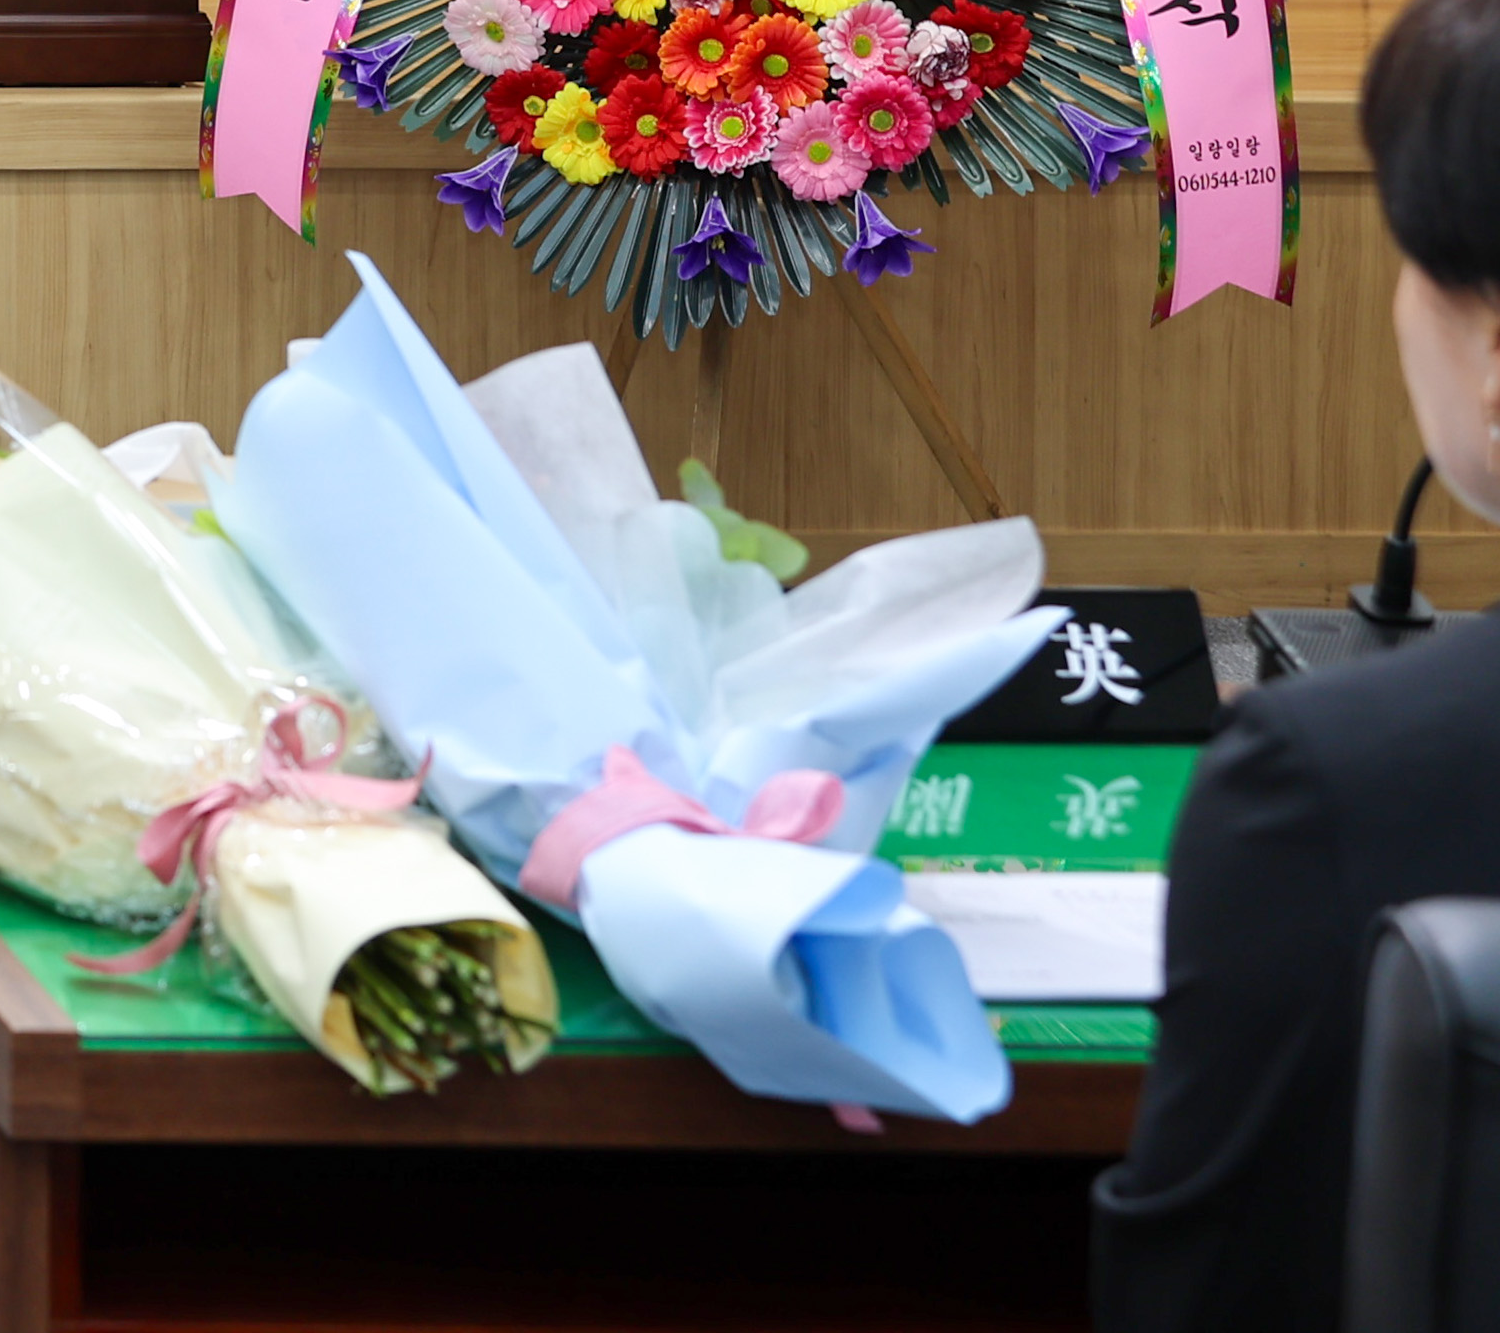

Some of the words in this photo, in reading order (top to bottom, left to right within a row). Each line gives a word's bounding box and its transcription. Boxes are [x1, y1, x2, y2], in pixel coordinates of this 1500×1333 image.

[1188, 135, 1261, 162] 일랑일랑
[1177, 165, 1277, 193] 061)544-1210
[1048, 620, 1146, 707] 英
